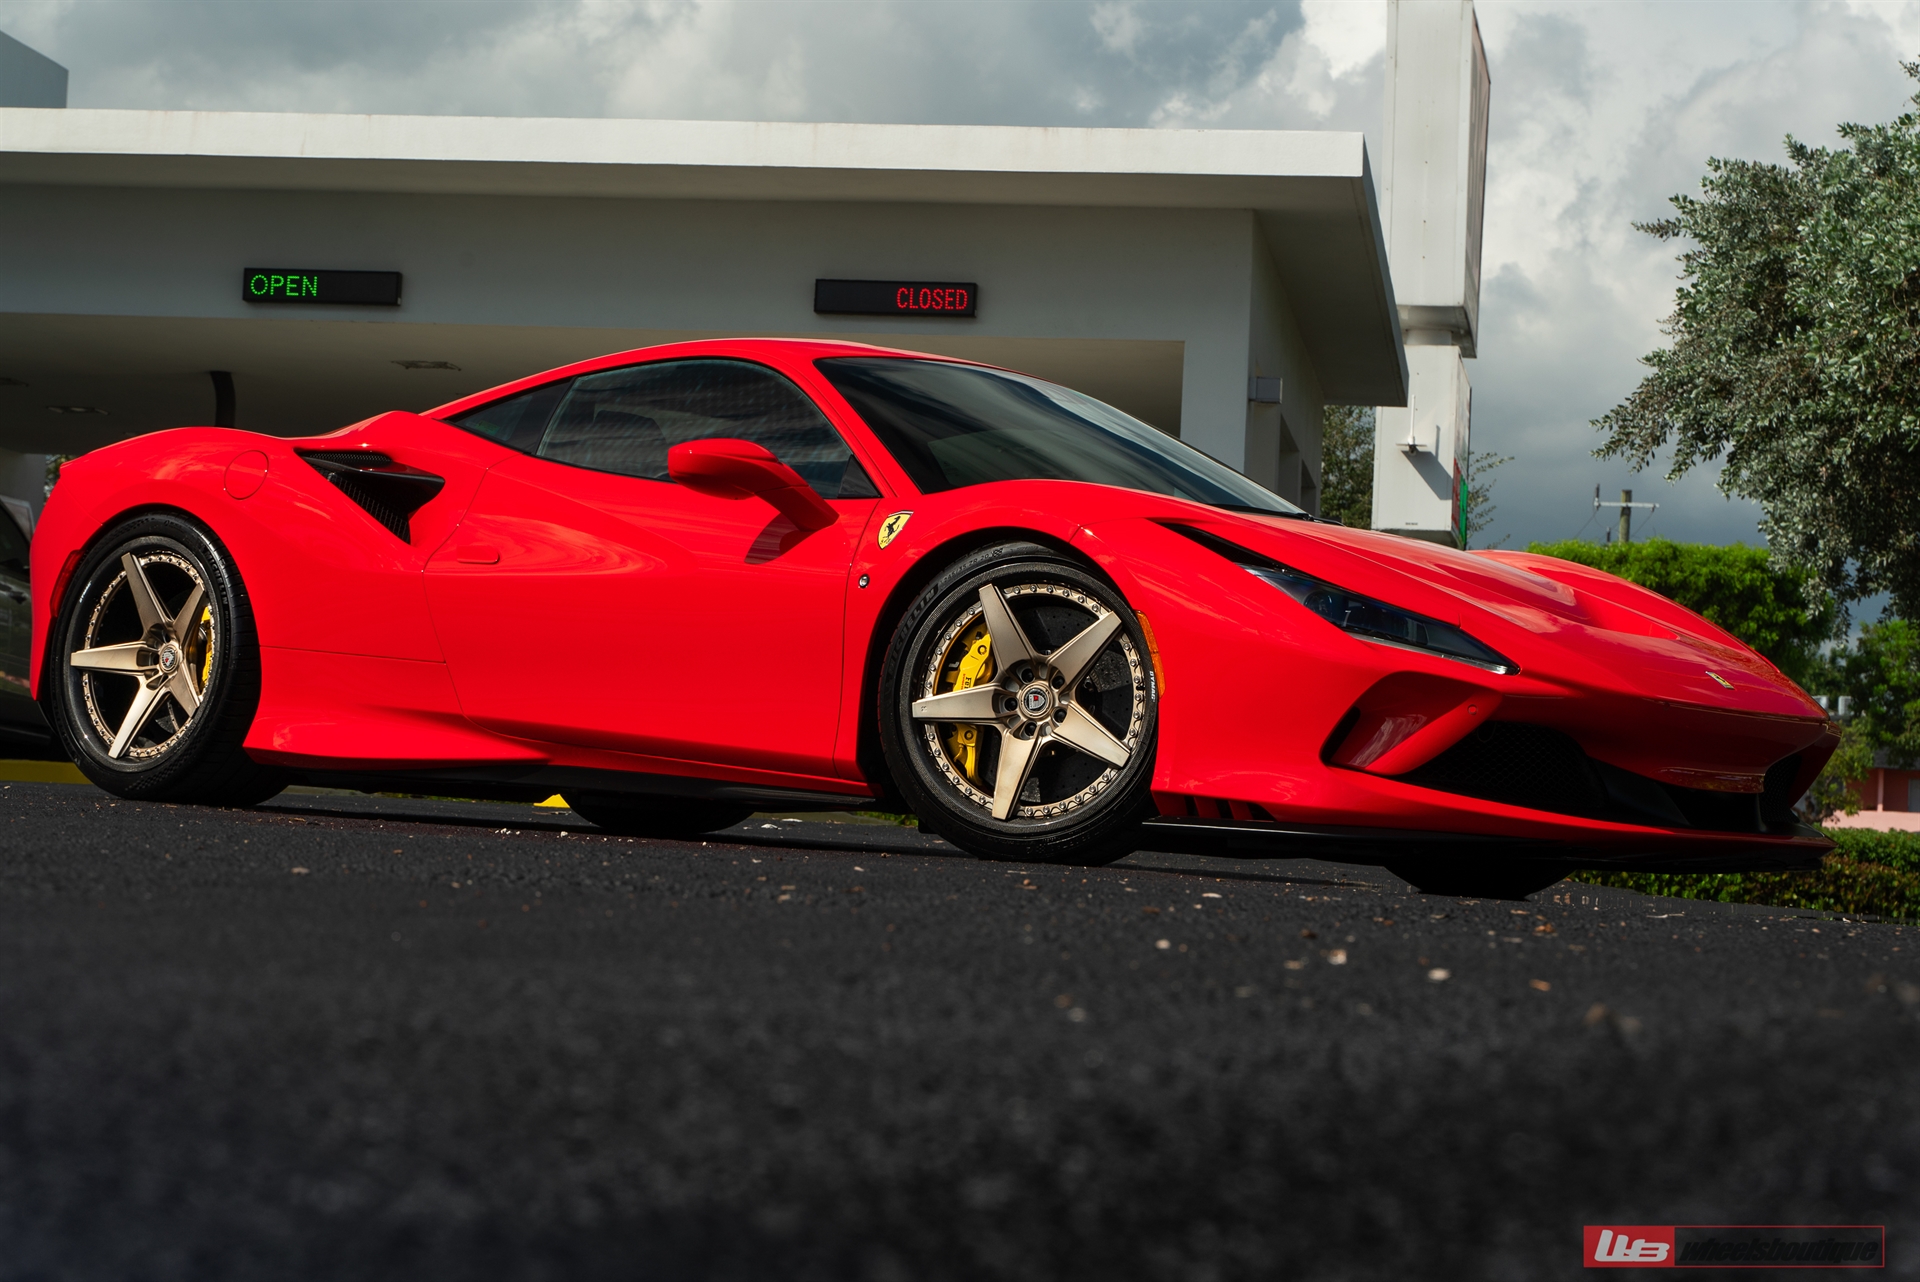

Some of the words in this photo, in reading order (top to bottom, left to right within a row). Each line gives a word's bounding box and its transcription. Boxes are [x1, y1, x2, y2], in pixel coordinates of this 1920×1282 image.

[250, 274, 318, 297] OPEN
[896, 287, 968, 310] CLOSED
[887, 587, 936, 676] MICHELIN
